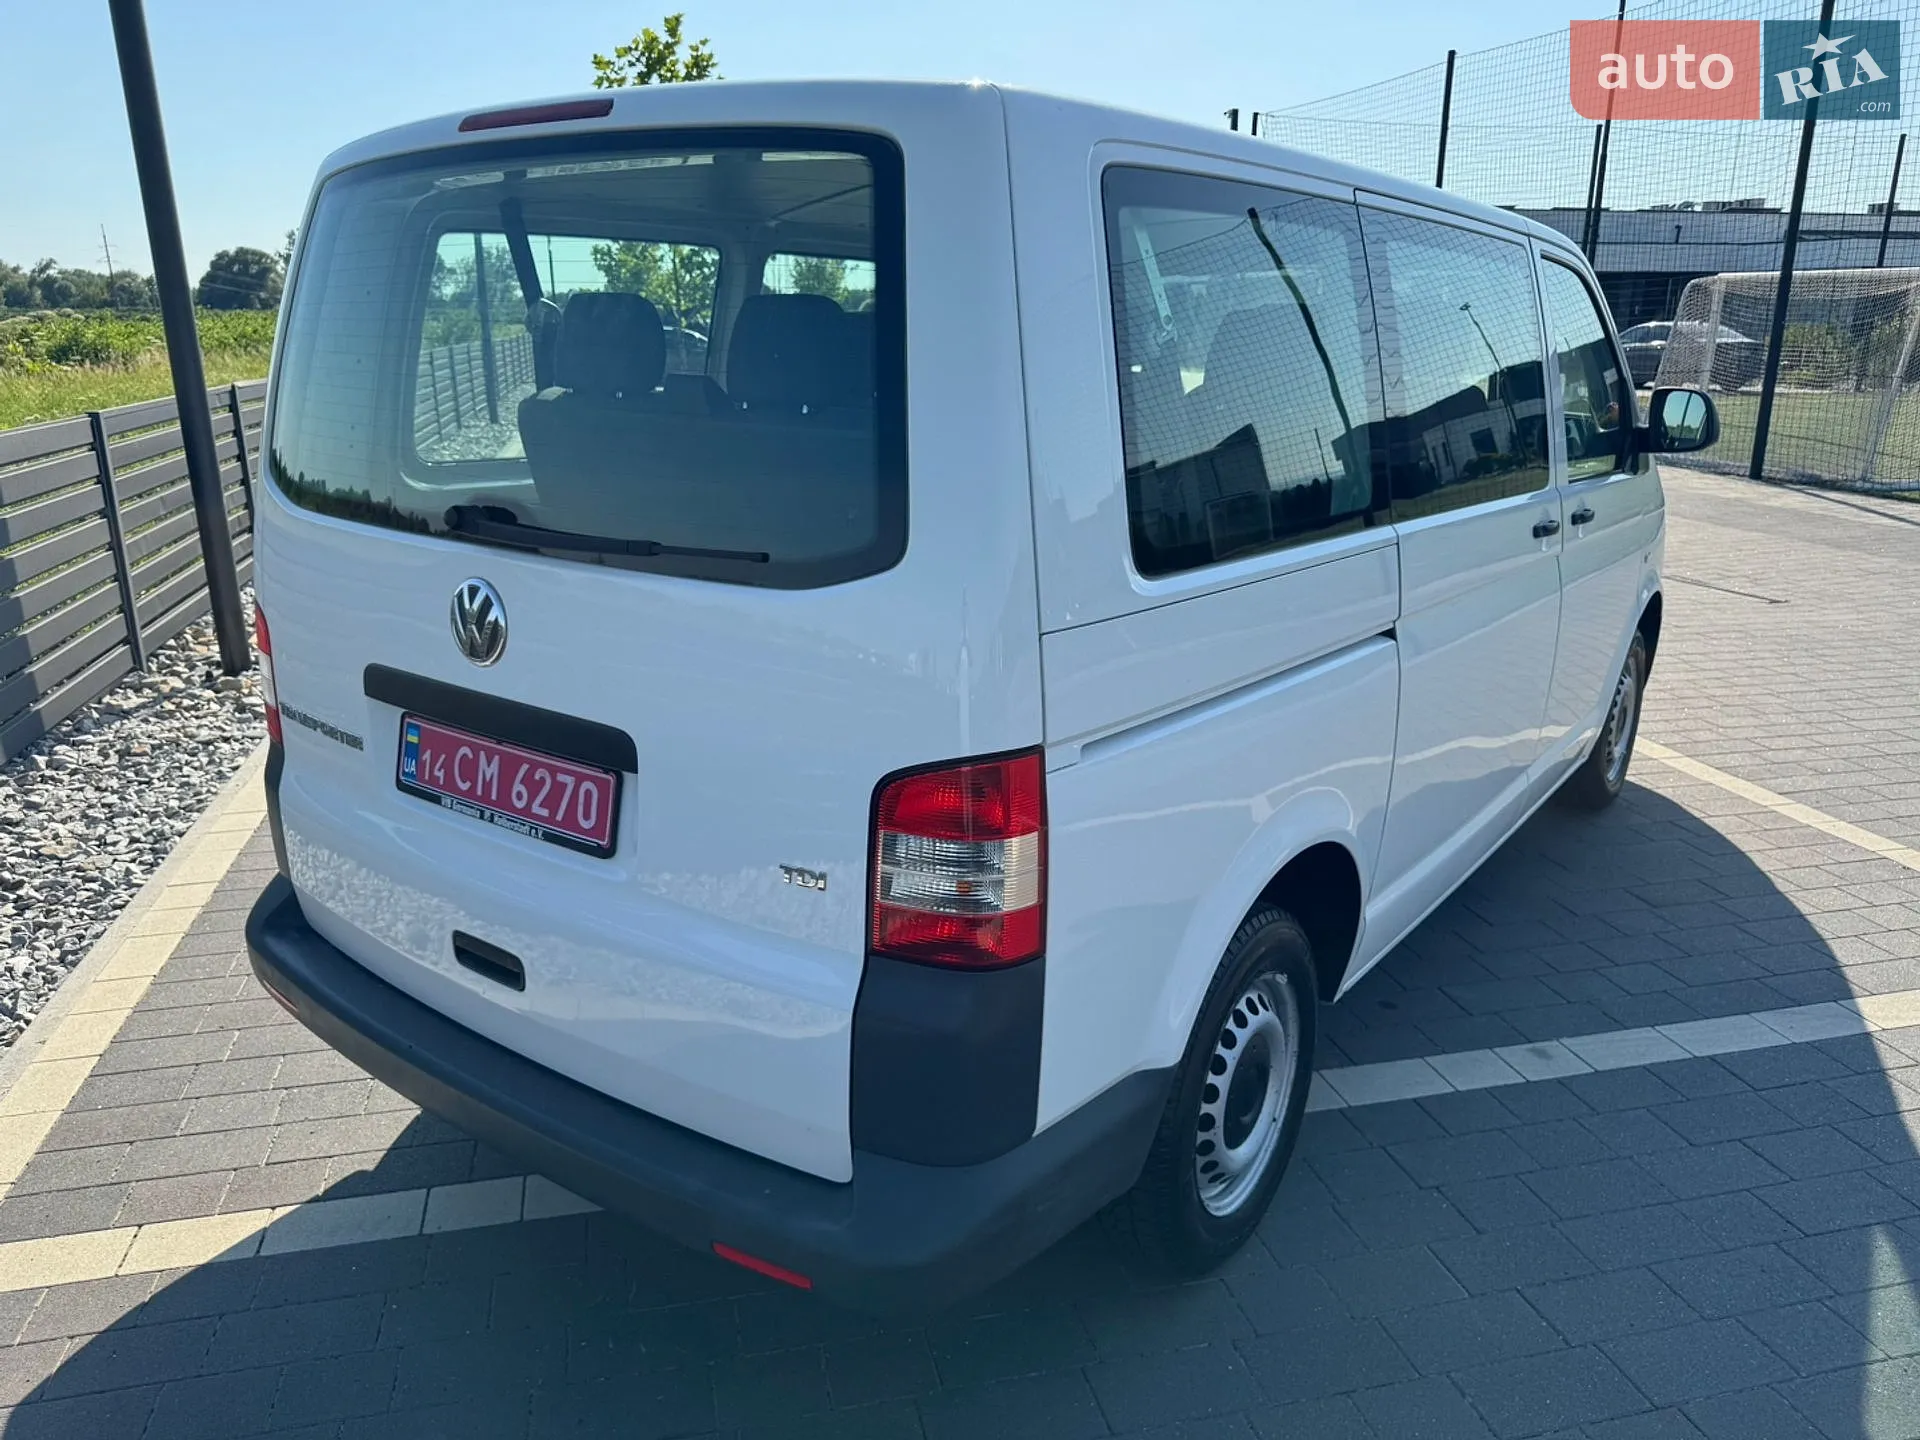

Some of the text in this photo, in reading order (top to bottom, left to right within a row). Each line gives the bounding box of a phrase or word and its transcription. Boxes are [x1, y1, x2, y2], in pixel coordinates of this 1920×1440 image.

[403, 756, 416, 776] UA
[422, 746, 599, 830] 14 CM 6270
[779, 865, 827, 891] TDI
